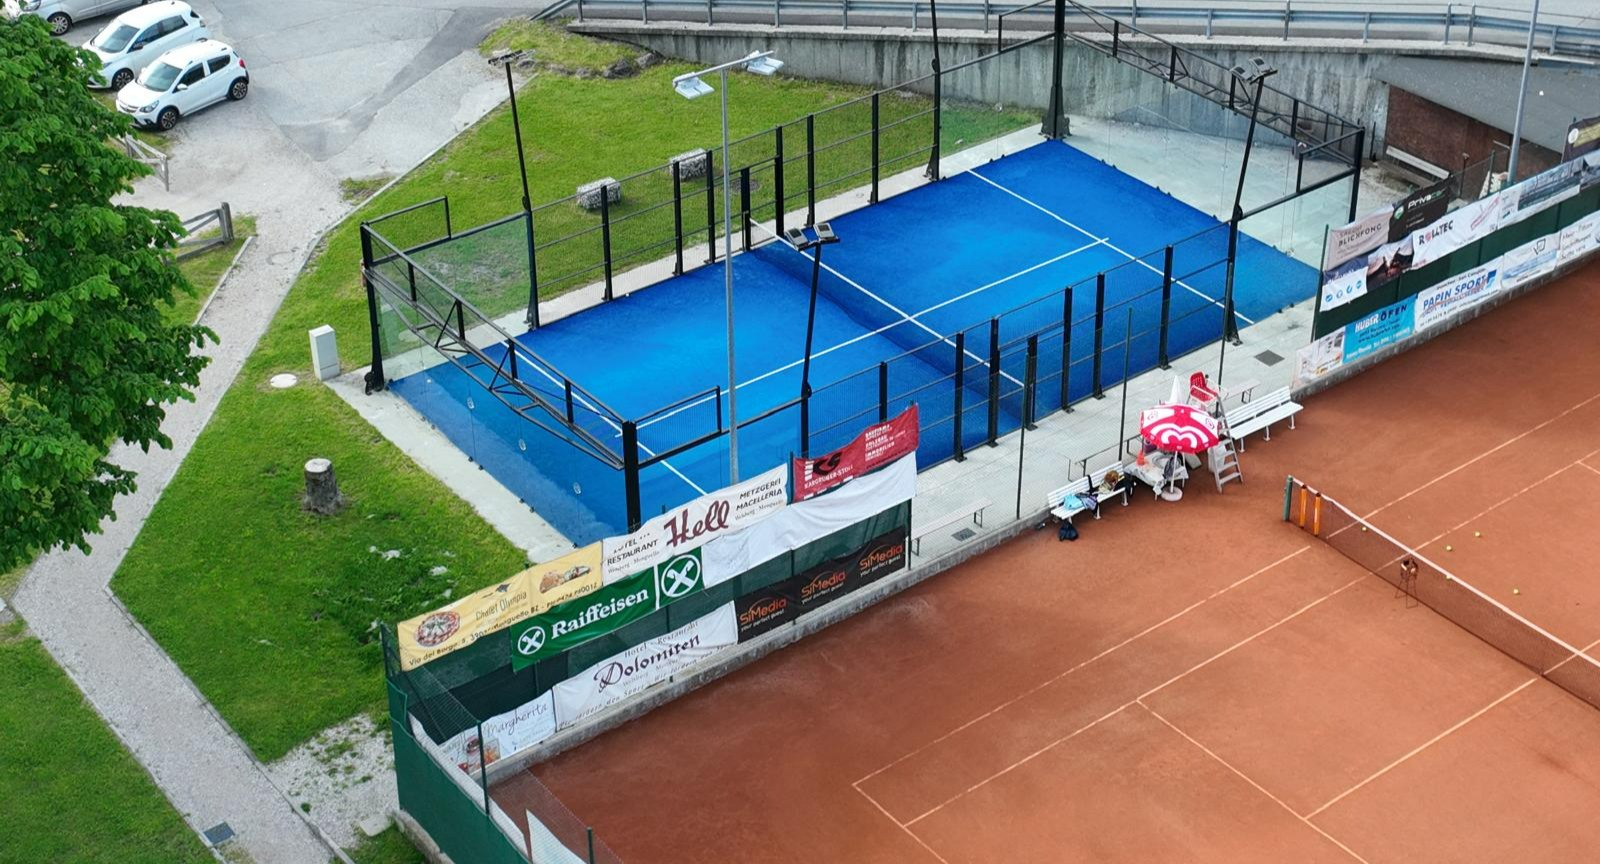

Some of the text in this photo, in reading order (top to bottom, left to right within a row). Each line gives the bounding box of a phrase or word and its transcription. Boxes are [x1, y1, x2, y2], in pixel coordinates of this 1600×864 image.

[1418, 220, 1454, 245] ROLLTEC
[1423, 289, 1452, 310] PAPIN
[1454, 274, 1487, 296] SPORT
[1355, 313, 1379, 333] HUBER
[735, 489, 783, 511] MACELLERIA
[739, 477, 781, 499] METZGEREI
[663, 500, 730, 548] Hell
[607, 539, 659, 566] RESTAURANT
[475, 591, 527, 621] Chalet Olympia
[551, 587, 649, 640] Raiffeisen
[624, 621, 699, 659] Hotel Restaurant
[409, 656, 422, 666] Via
[423, 650, 436, 662] del
[593, 634, 700, 694] Dolomiten
